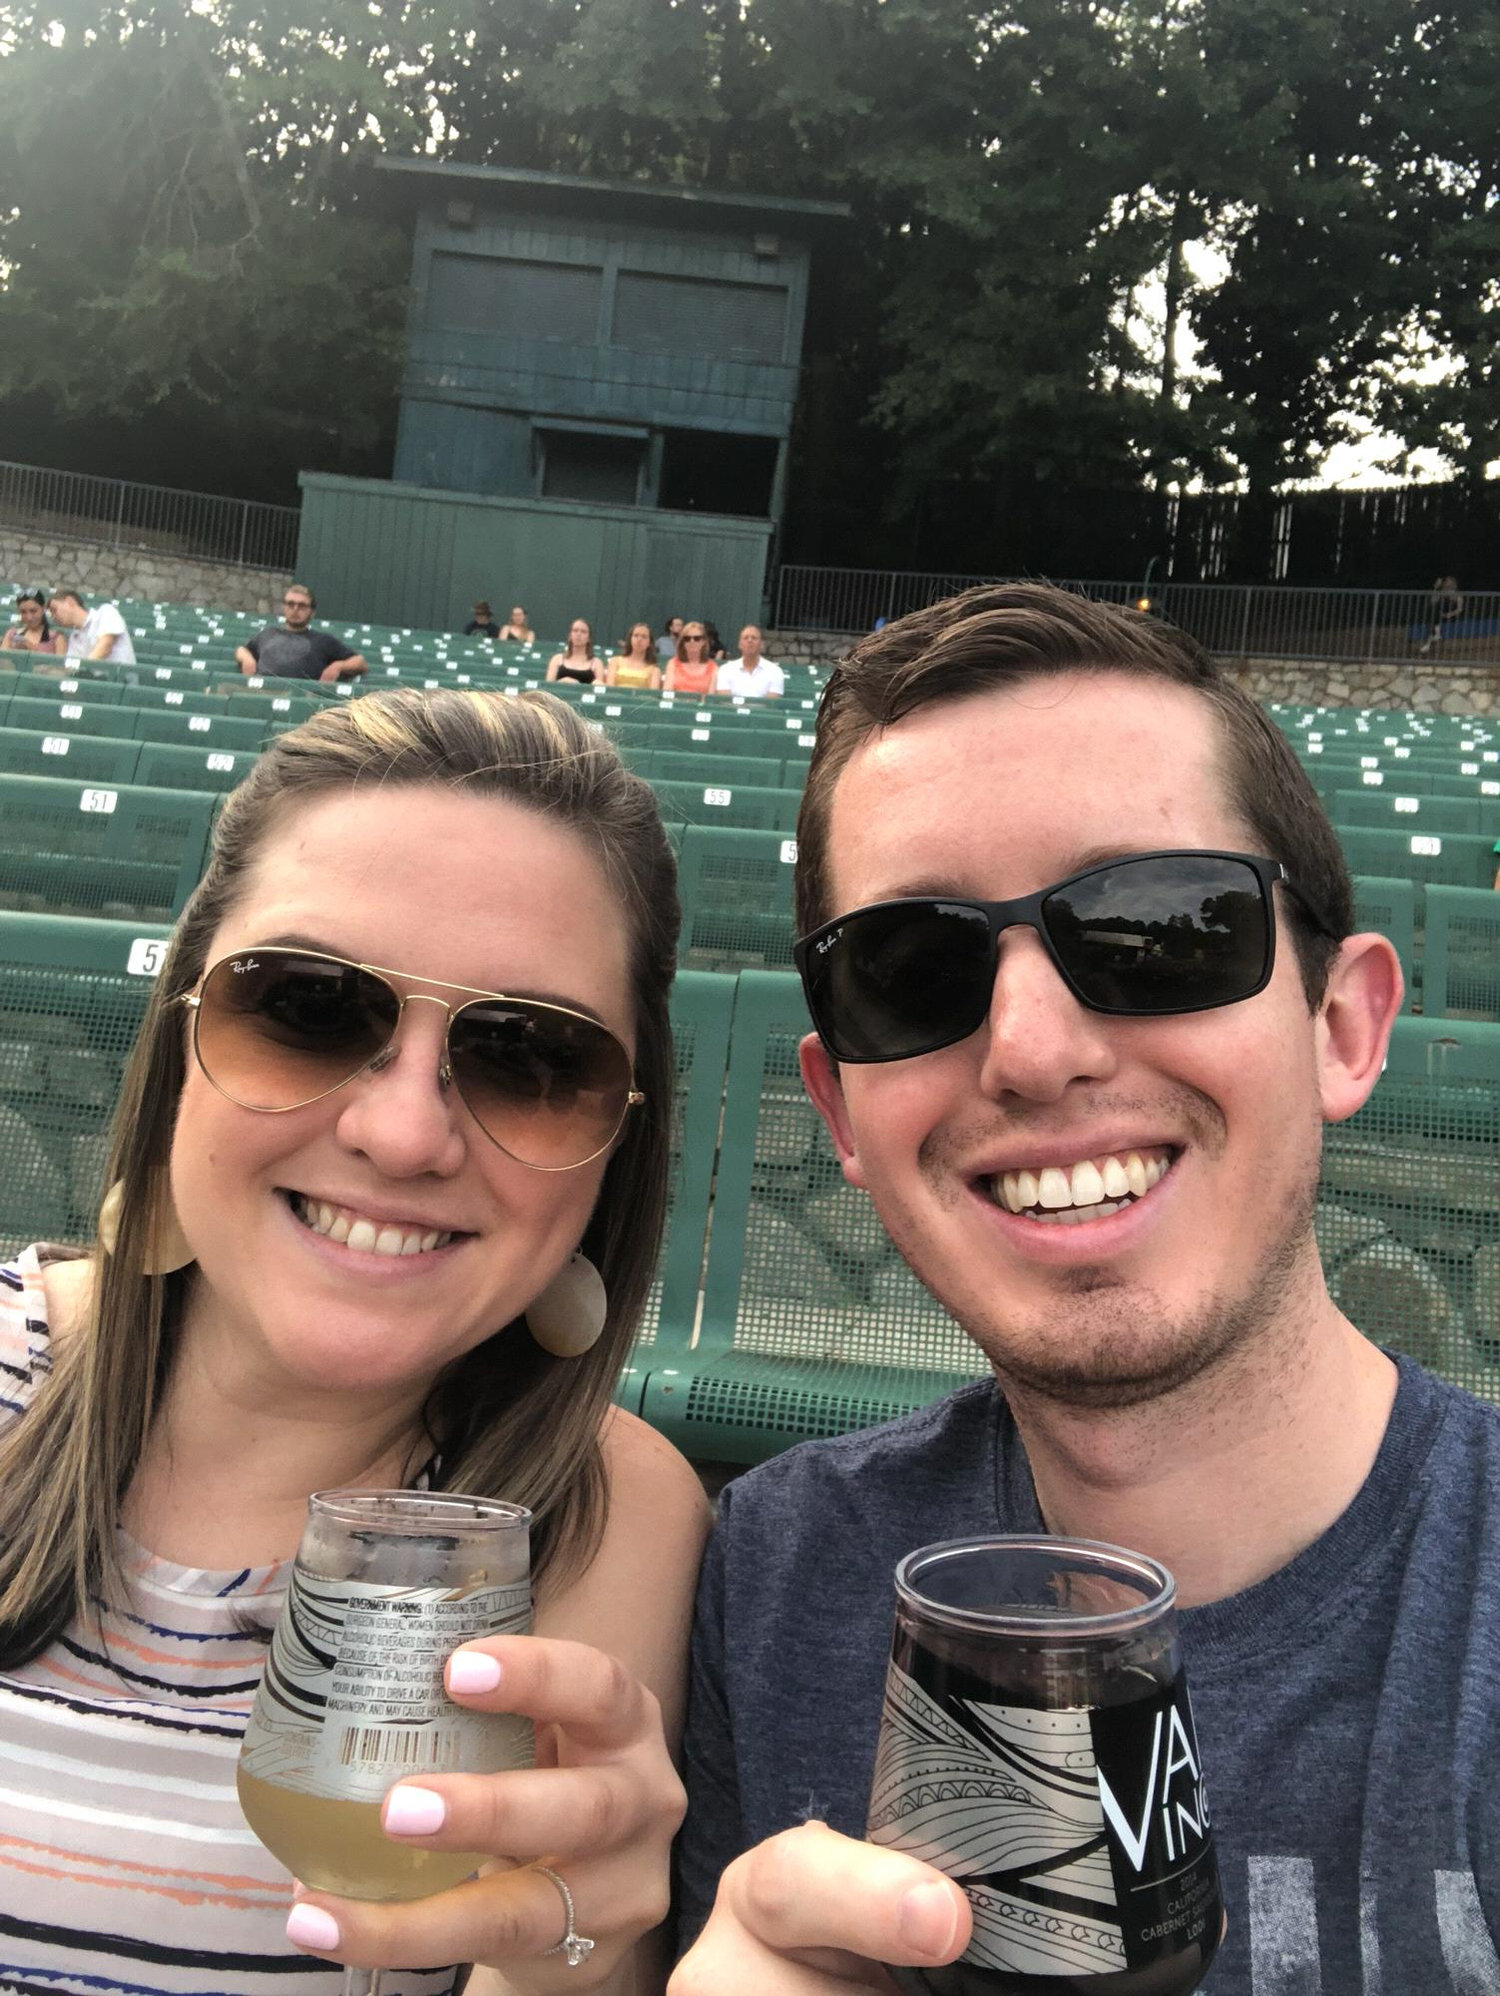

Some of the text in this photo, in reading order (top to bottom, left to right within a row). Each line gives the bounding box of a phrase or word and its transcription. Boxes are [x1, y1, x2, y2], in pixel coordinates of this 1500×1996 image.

[229, 958, 260, 974] Ray-Ban
[350, 1597, 391, 1612] GOVERNMENT
[435, 1602, 469, 1615] ACCORDING
[470, 1603, 478, 1614] TO
[408, 1620, 434, 1631] WOMEN
[435, 1620, 460, 1631] SHOULD
[461, 1620, 473, 1631] NOT
[342, 1631, 376, 1646] ALCOHOLIC
[377, 1634, 415, 1648] BEVERAGES
[416, 1637, 442, 1649] DURING
[337, 1647, 368, 1661] BECAUSE
[368, 1651, 377, 1662] OF
[378, 1651, 392, 1663] THE
[393, 1652, 408, 1664] RISK
[409, 1653, 418, 1665] OF
[419, 1653, 440, 1665] BIRTH
[335, 1664, 382, 1681] CONSUMPTION
[383, 1668, 393, 1682] OF
[394, 1670, 431, 1683] ALCOHOLIC
[332, 1680, 350, 1694] YOUR
[350, 1683, 376, 1697] ABILITY
[377, 1686, 386, 1697] TO
[386, 1687, 407, 1699] DRIVE
[408, 1687, 415, 1699] A
[416, 1688, 430, 1700] CAR
[369, 1703, 384, 1715] AND
[386, 1704, 402, 1716] MAY
[402, 1705, 427, 1717] CAUSE
[1141, 1910, 1191, 1941] CABERNET
